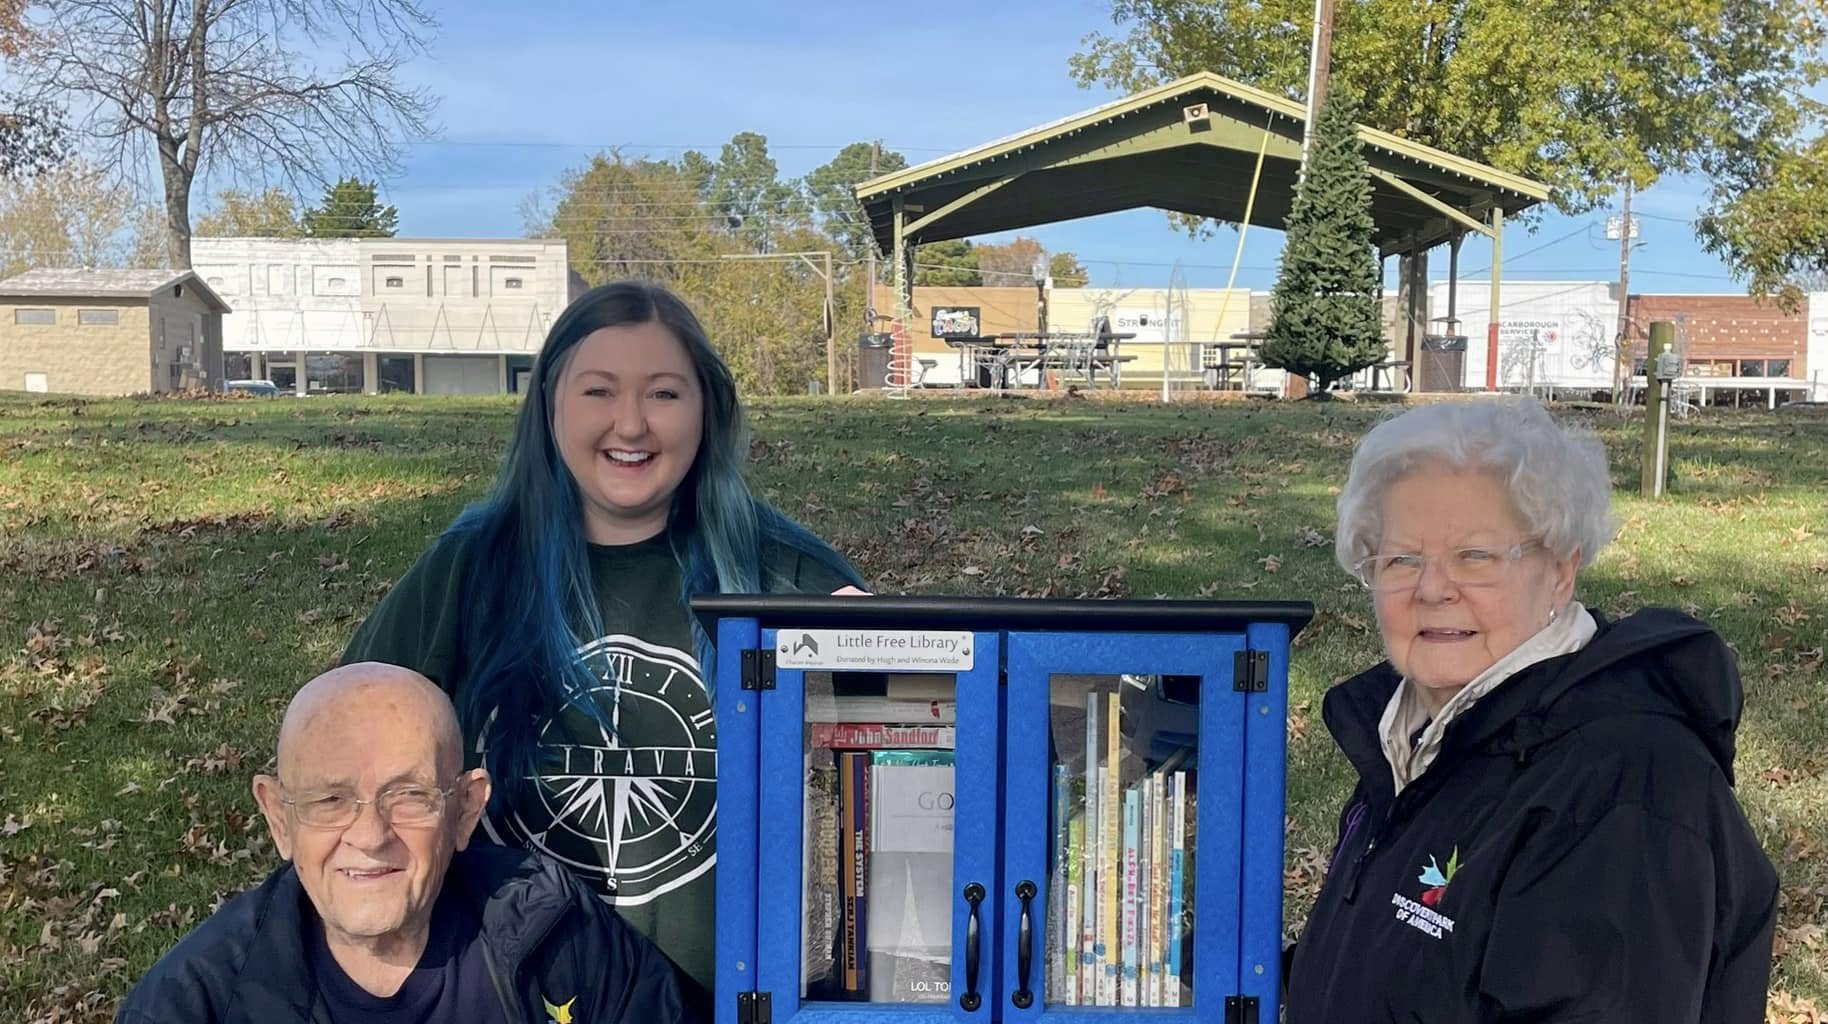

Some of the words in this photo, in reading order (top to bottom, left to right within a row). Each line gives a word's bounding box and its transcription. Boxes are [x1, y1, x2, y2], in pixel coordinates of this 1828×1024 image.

[837, 634, 873, 648] Little
[876, 635, 906, 648] Free
[910, 635, 959, 652] Library
[836, 655, 866, 664] Donated
[867, 655, 876, 665] by
[877, 656, 896, 665] Hugh
[897, 656, 911, 665] and
[911, 657, 938, 665] Winona
[850, 727, 882, 744] John
[855, 829, 864, 852] THE
[687, 842, 703, 857] SE
[855, 852, 865, 897] SYSTEM
[606, 877, 618, 891] S
[1396, 908, 1411, 921] OF
[1406, 914, 1443, 939] AMERICA
[846, 923, 855, 970] TANKIAN
[911, 981, 931, 992] LOL
